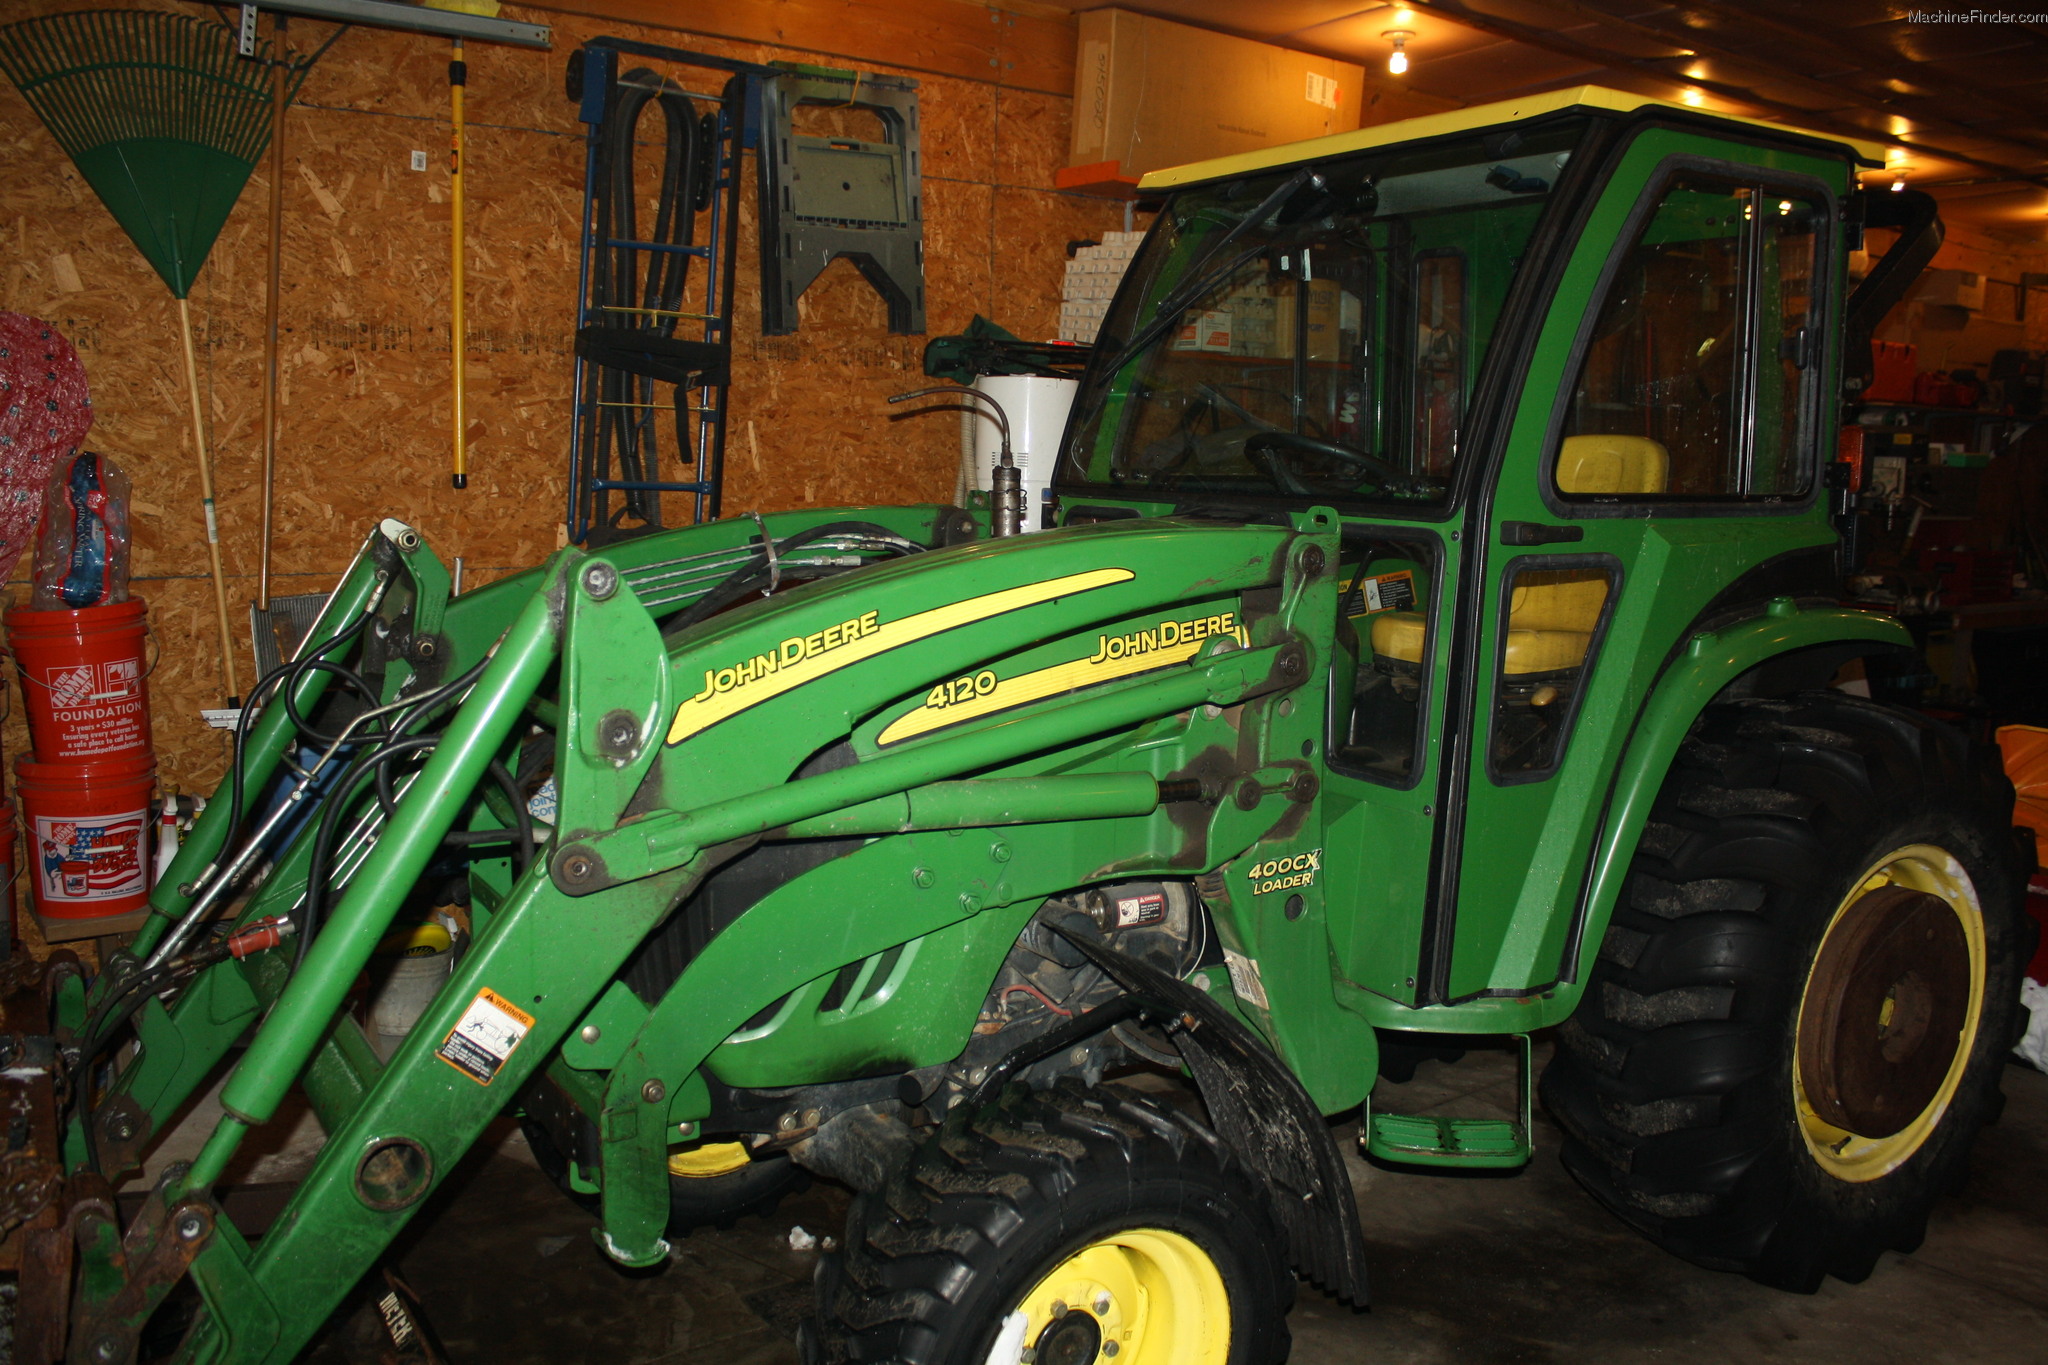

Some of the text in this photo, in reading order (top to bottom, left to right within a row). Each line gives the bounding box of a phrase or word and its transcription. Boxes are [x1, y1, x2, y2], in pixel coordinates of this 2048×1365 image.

[1090, 612, 1235, 664] JOHN DEERE
[694, 609, 880, 703] JOHN DEERE
[51, 667, 93, 708] HOME
[926, 670, 998, 709] 4120
[53, 701, 142, 722] FOUNDATION
[62, 732, 90, 741] Ensuring
[90, 730, 109, 739] every
[76, 724, 95, 732] years
[73, 740, 87, 748] safe
[88, 738, 105, 748] place
[114, 735, 124, 743] call
[1248, 849, 1321, 880] 400CX
[1253, 872, 1313, 897] LOADER
[495, 999, 529, 1024] WARNING
